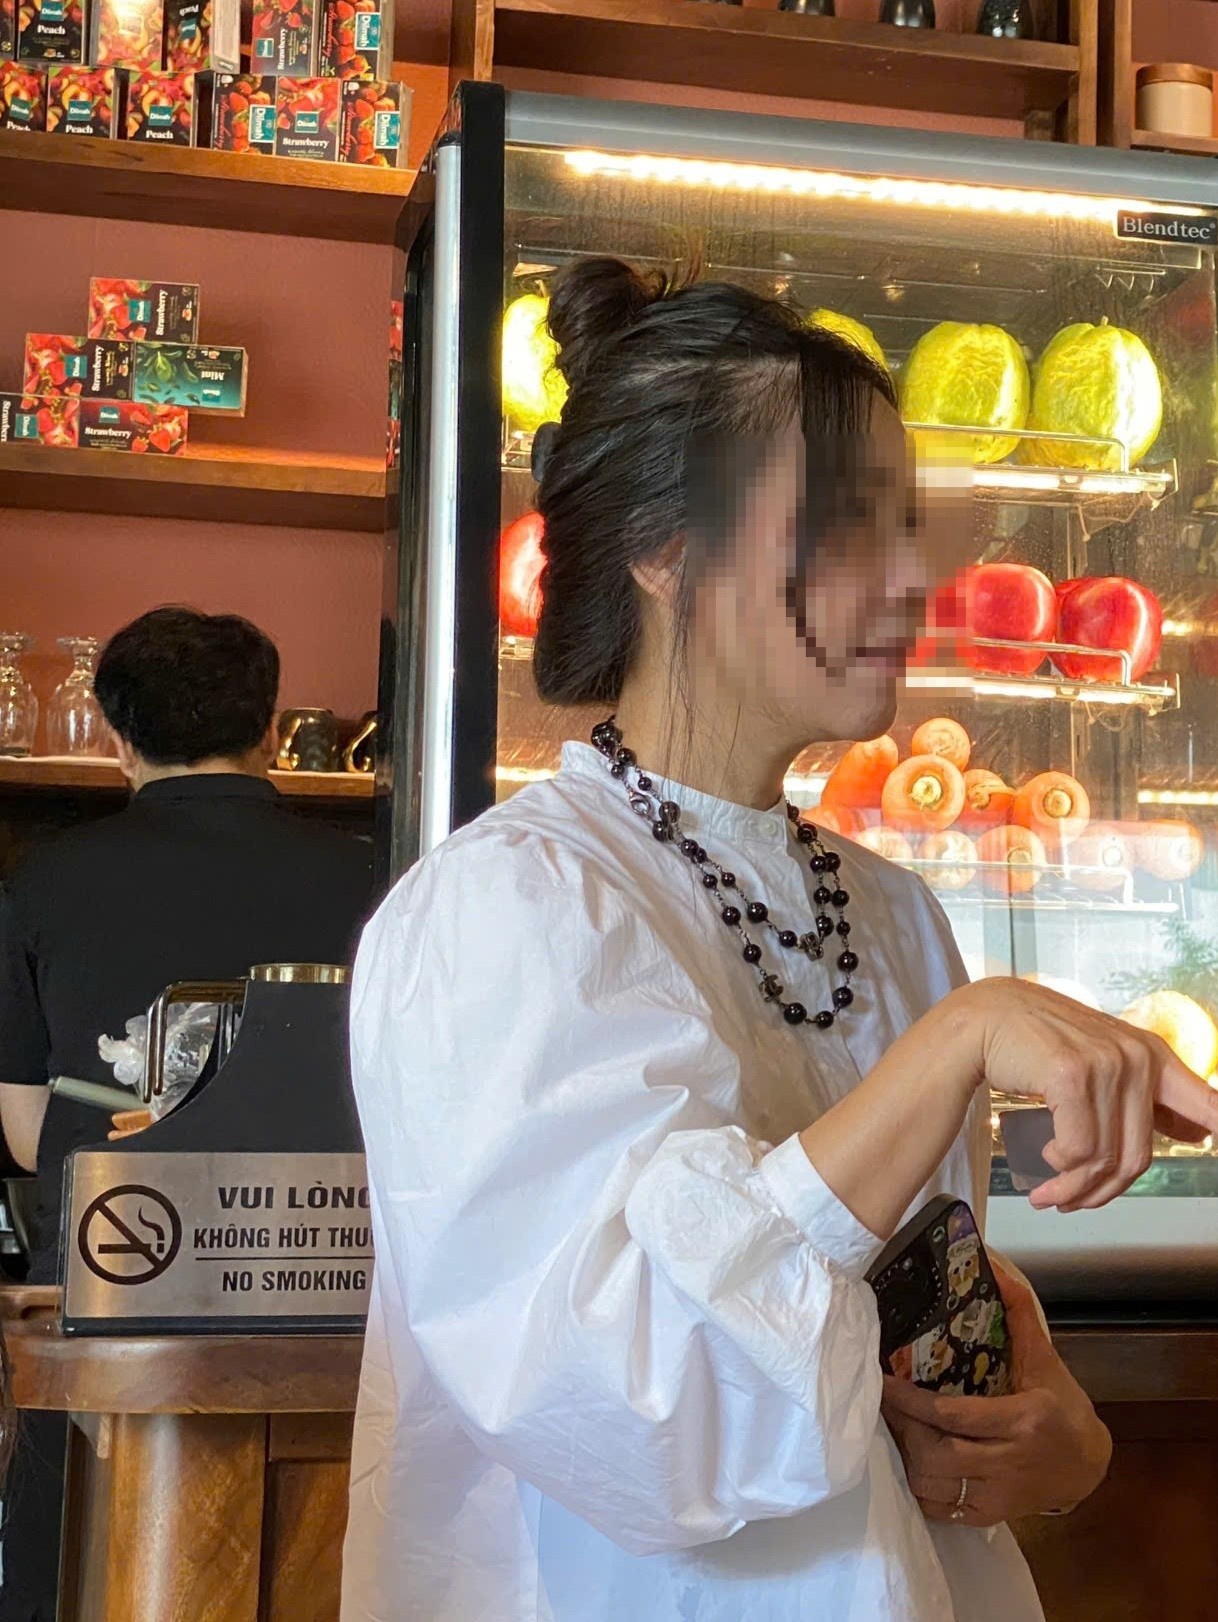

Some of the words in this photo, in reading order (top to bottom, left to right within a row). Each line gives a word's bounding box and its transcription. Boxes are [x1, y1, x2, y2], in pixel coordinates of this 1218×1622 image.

[37, 25, 66, 35] Peach
[359, 15, 371, 47] Dilmah
[277, 27, 288, 70] Strawberry
[65, 124, 93, 134] Peach
[254, 107, 266, 139] Dilmah
[380, 114, 391, 146] Dilmah
[145, 130, 173, 139] Peach
[282, 137, 329, 149] Strawberry
[155, 289, 168, 336] Strawberry
[91, 344, 104, 392] Strawberry
[201, 371, 225, 380] Mint
[84, 427, 132, 439] Strawberry
[218, 1187, 274, 1209] VUI
[194, 1223, 270, 1248] KHÔNG
[279, 1223, 320, 1248] HÚT
[328, 1227, 374, 1248] THU
[223, 1271, 253, 1291] NO
[261, 1270, 366, 1291] SMOKING
